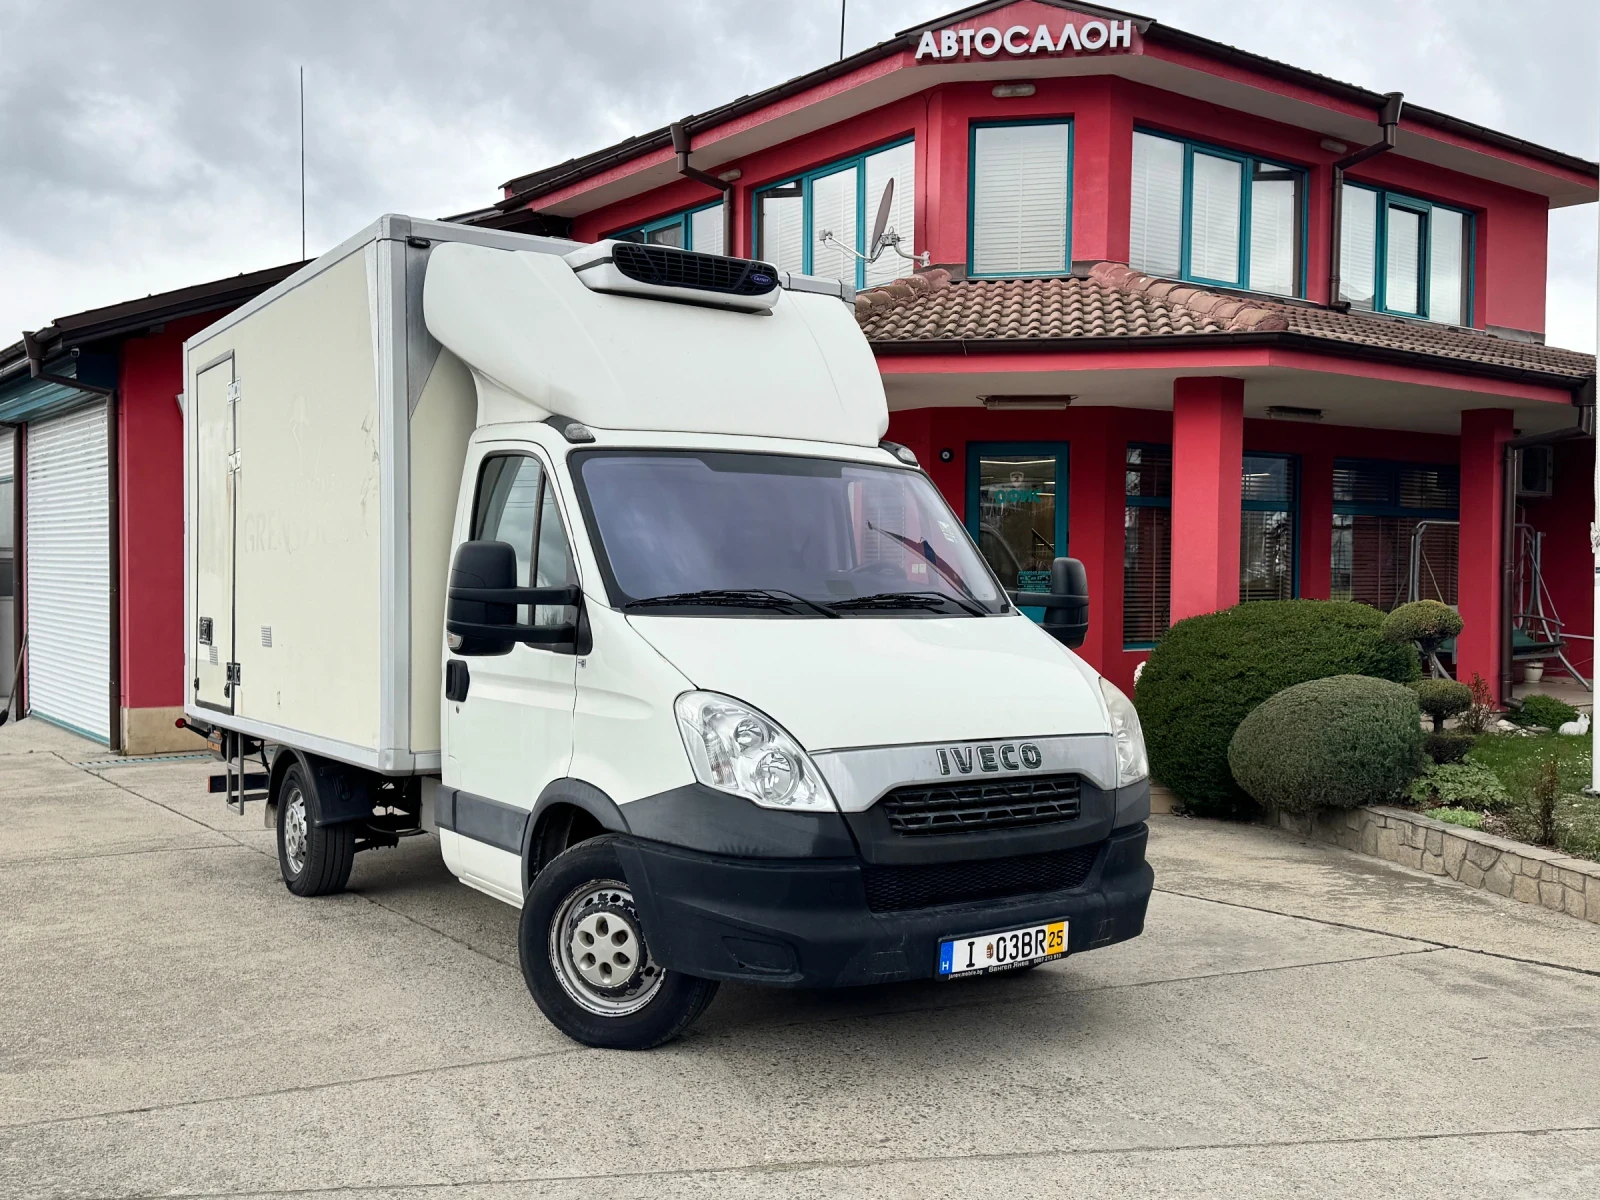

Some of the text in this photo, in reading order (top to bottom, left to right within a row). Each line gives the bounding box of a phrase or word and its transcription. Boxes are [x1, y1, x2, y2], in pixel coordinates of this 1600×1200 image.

[914, 19, 1132, 60] АВТОСАЛОН
[936, 743, 1042, 775] IVECO
[996, 929, 1047, 962] 03BR
[1048, 930, 1064, 948] 25
[942, 961, 950, 971] H
